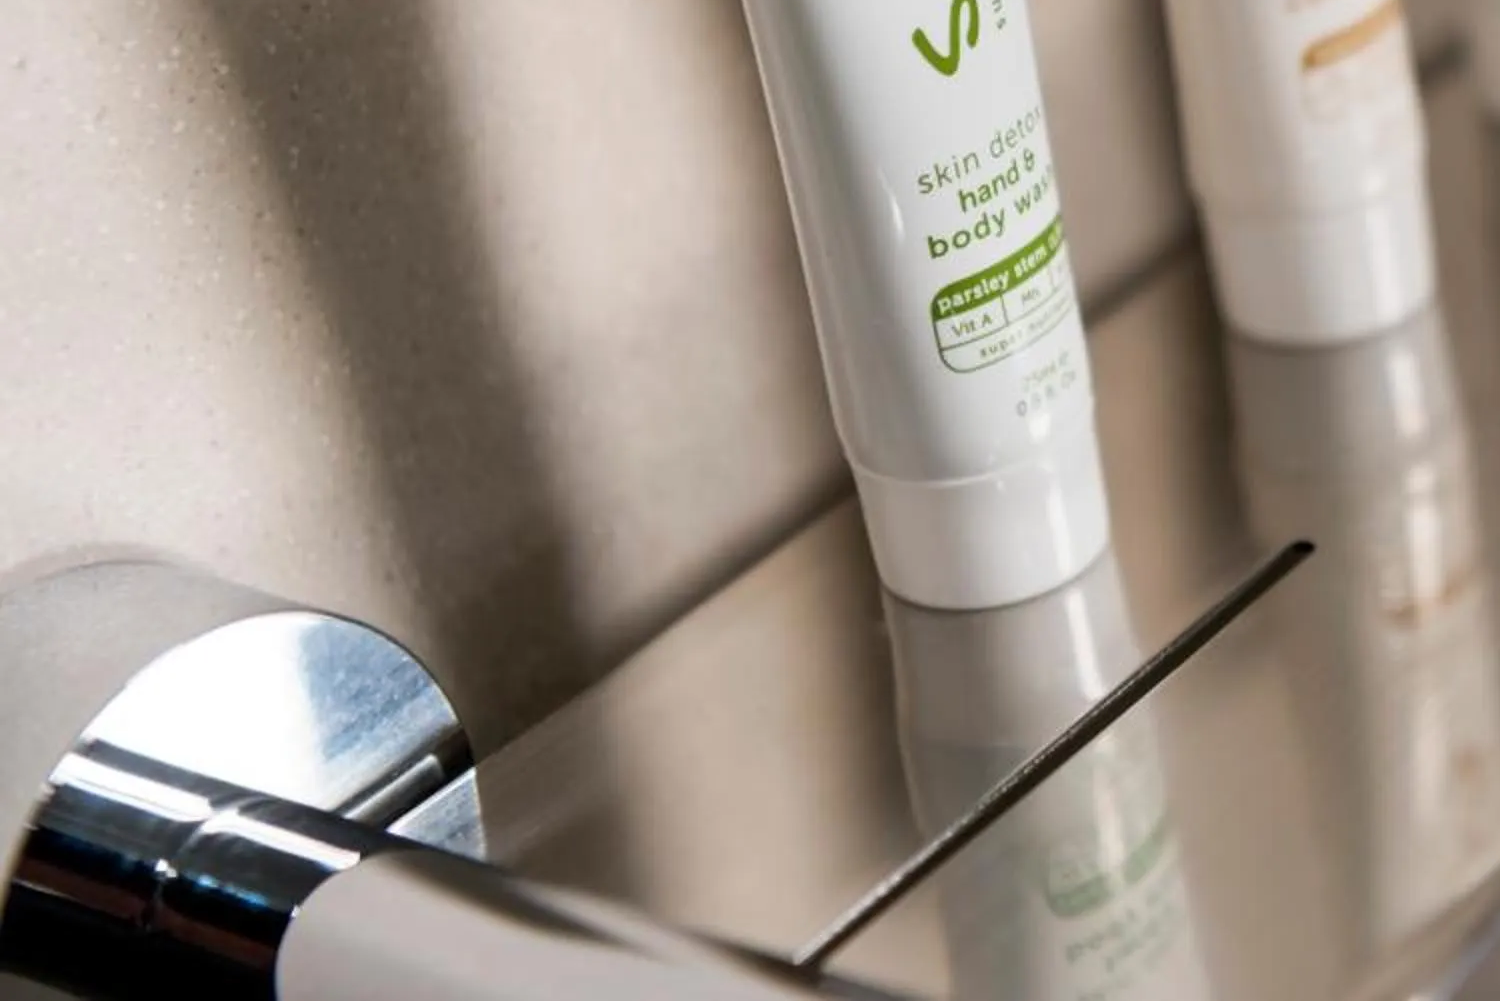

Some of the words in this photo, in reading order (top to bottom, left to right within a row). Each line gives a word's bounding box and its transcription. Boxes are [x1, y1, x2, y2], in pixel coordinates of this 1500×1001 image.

[917, 151, 981, 195] skin
[957, 156, 1020, 213] hand
[1022, 147, 1036, 173] &
[926, 208, 1006, 259] body
